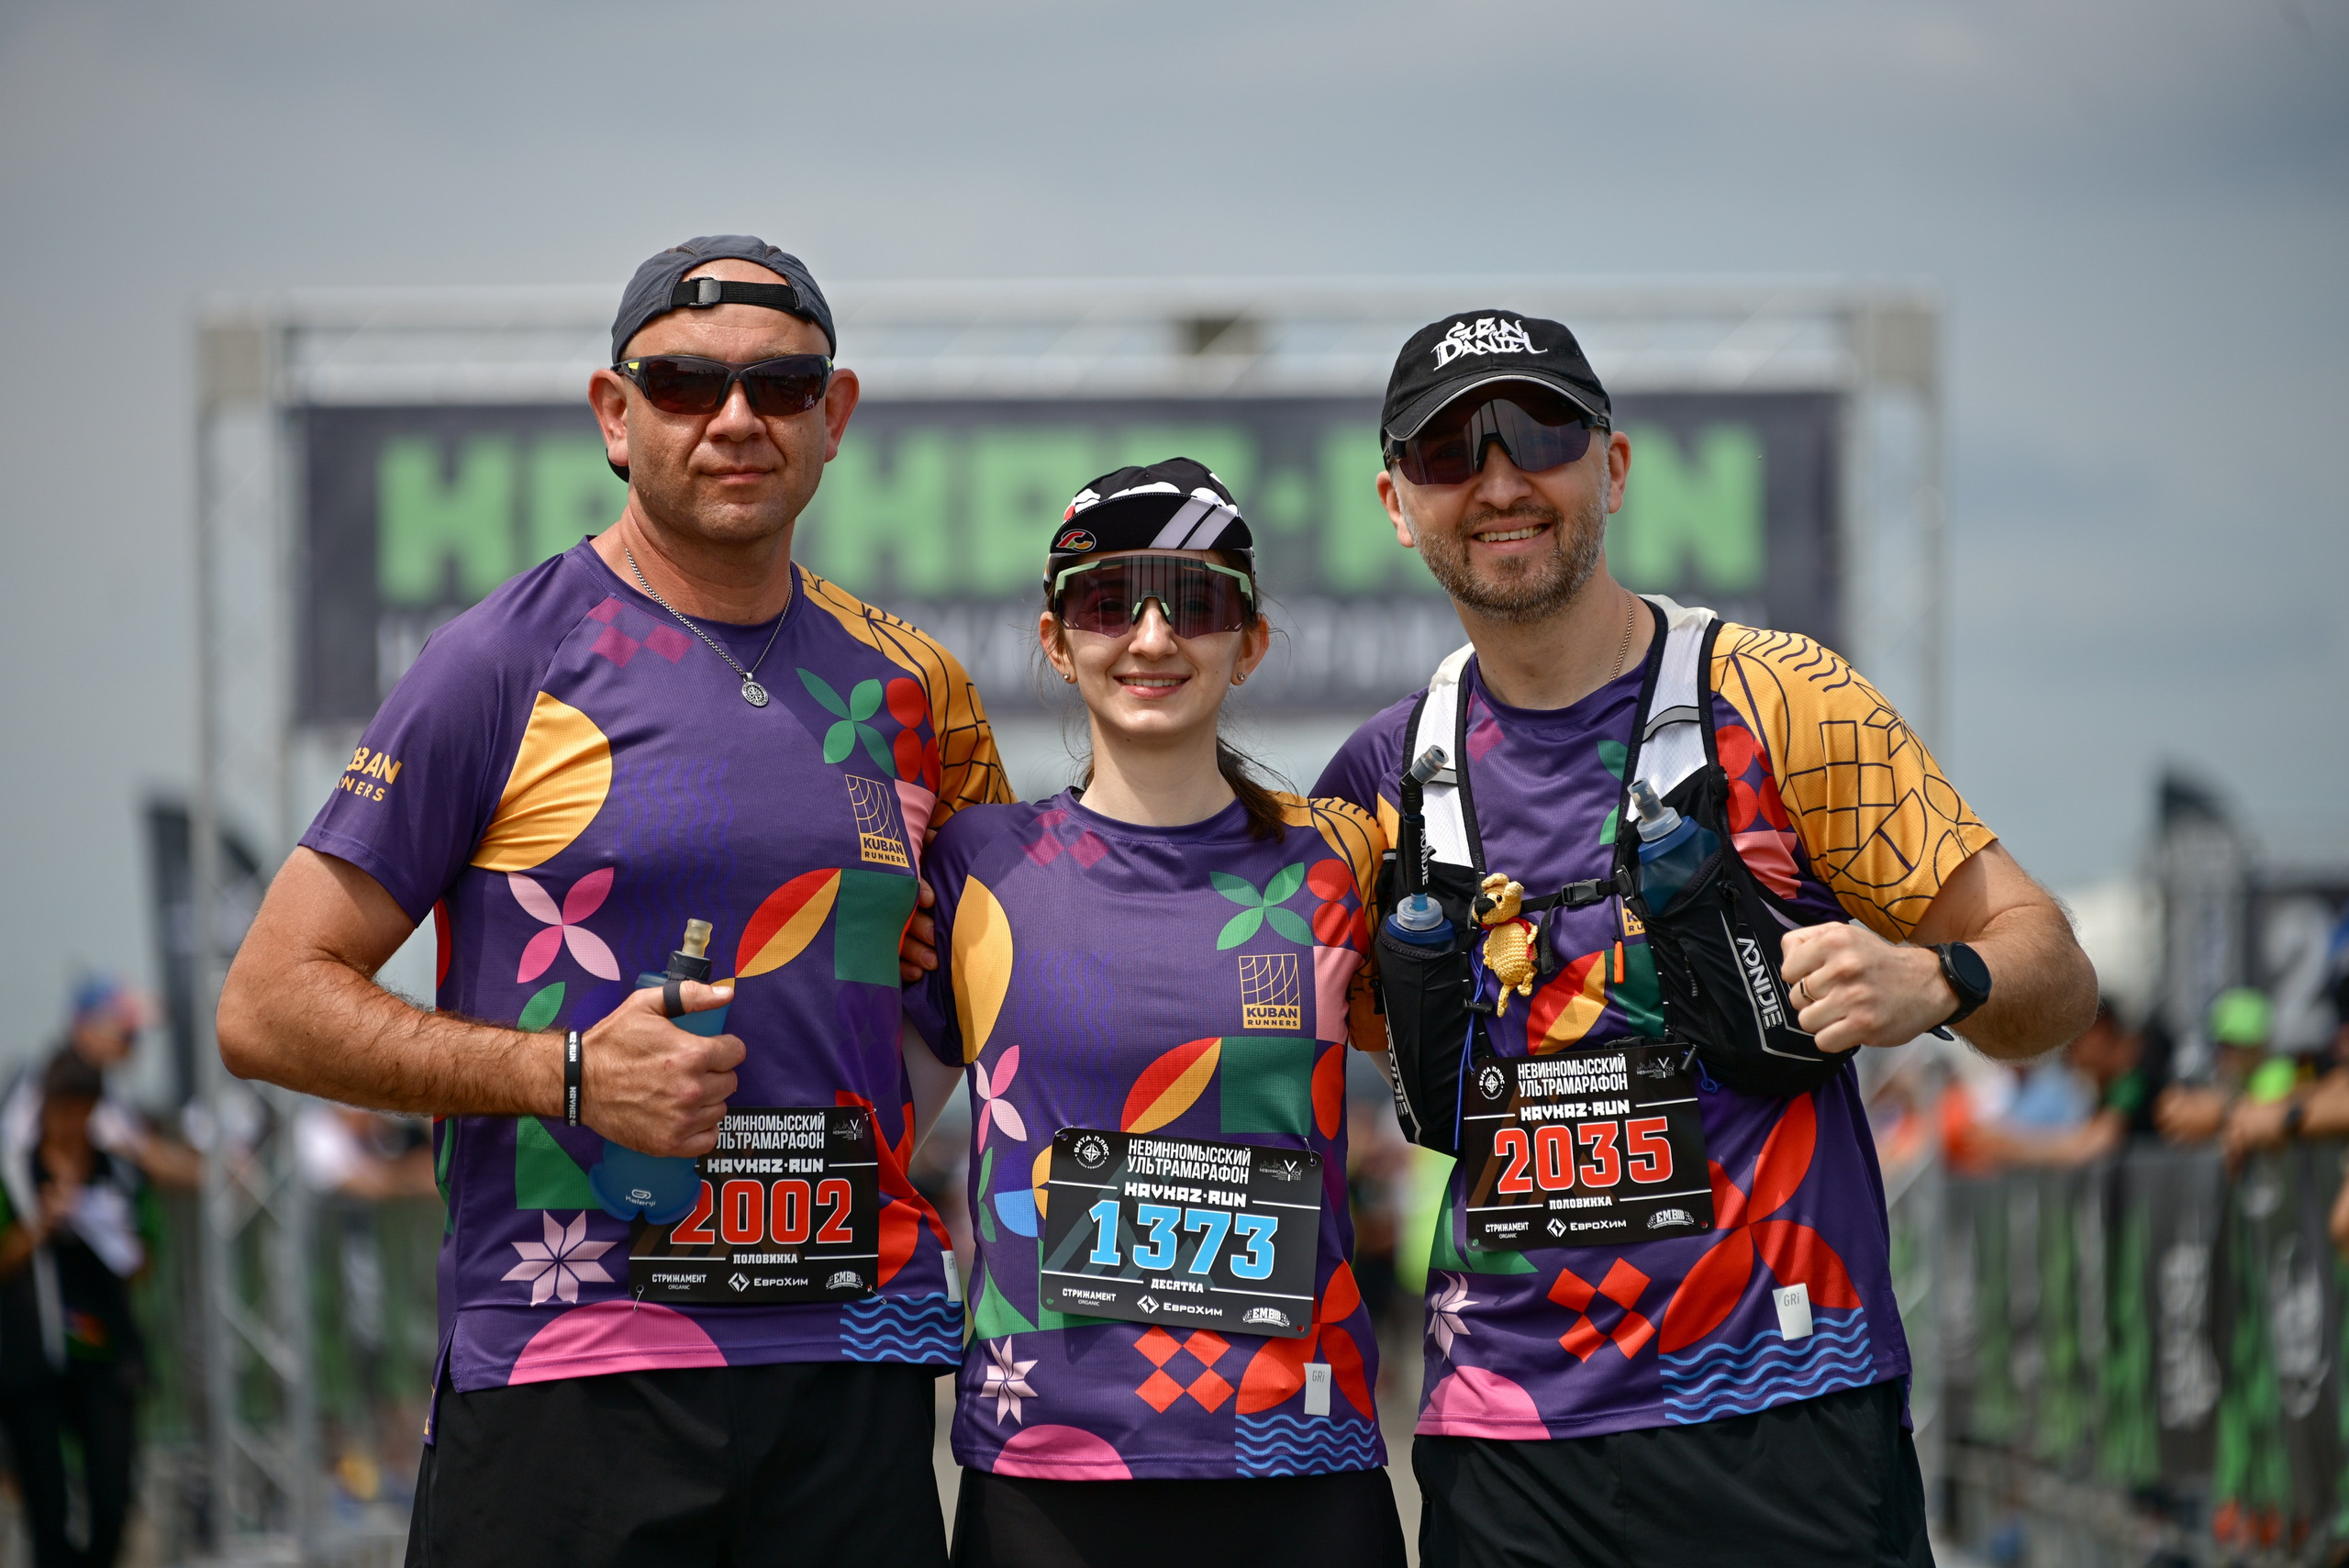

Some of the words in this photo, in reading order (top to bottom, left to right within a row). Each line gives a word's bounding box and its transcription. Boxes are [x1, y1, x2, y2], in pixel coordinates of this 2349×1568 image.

[346, 747, 402, 784] BAN
[863, 837, 904, 855] KUBAN
[865, 851, 906, 864] RUNNERS
[1247, 1007, 1297, 1018] KUBAN
[1518, 1053, 1627, 1080] НЕВИННОМЫССКИЙ
[1519, 1073, 1629, 1098] УЛЬТРАМАРАФОН
[717, 1131, 825, 1150] ЛЬТРАМАРАФОН
[1074, 1135, 1092, 1153] ВИТА
[1094, 1135, 1109, 1156] ПЛЮС
[1128, 1139, 1252, 1166] НЕВИННОМЫССКИЙ
[1495, 1116, 1673, 1194] 2035
[1127, 1155, 1249, 1184] УЛЬТРАМАРАФОН
[670, 1178, 853, 1245] 2002
[1549, 1196, 1613, 1210] ПОЛОВИНКА
[1486, 1221, 1530, 1233] СТРИЖАМЕНТ
[1088, 1199, 1278, 1280] 1373
[733, 1253, 798, 1264] ПОЛОВИНКА
[651, 1273, 707, 1284] СТРИЖАМЕНТ
[1151, 1278, 1204, 1294] ДЕСЯТКА
[1063, 1288, 1117, 1302] СТРИЖАМЕНТ
[1078, 1298, 1100, 1307] ORGANIC
